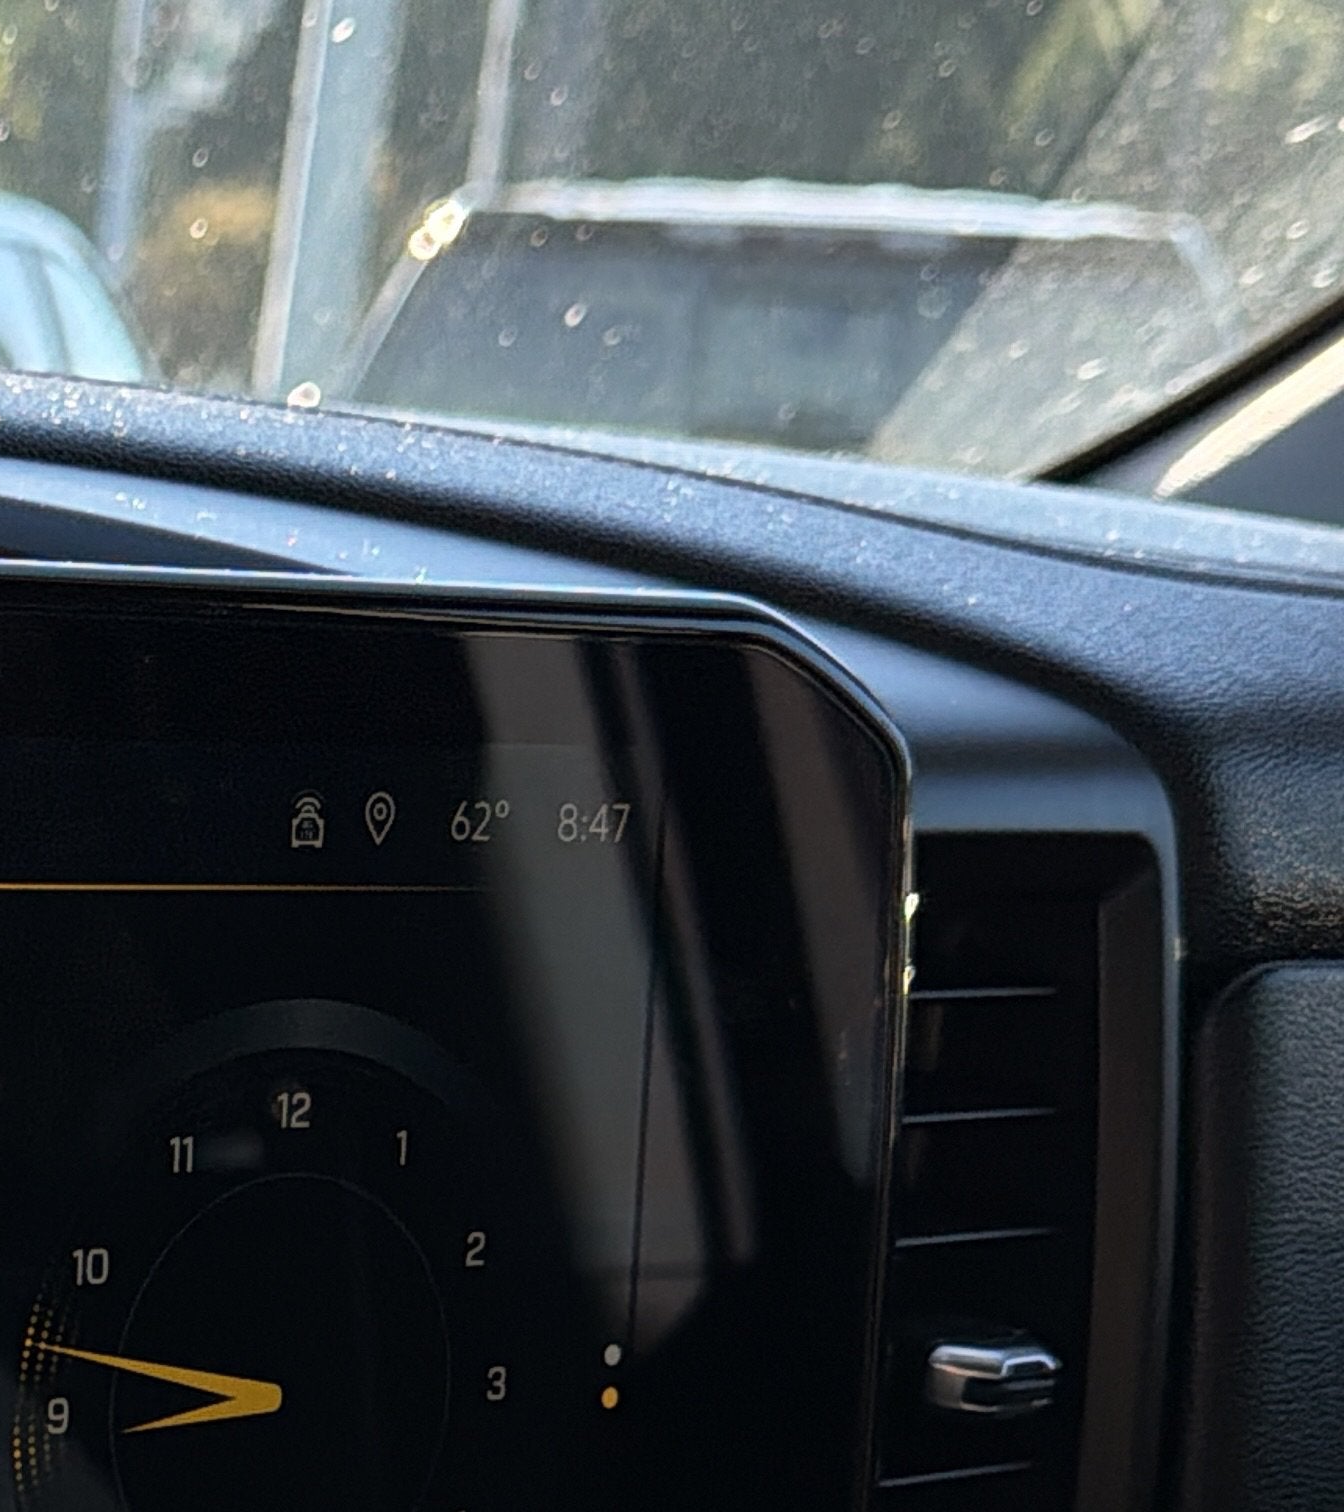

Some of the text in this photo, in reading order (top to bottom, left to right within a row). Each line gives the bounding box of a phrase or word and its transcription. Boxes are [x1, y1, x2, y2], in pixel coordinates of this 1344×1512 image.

[557, 802, 629, 843] 8:47
[277, 1091, 312, 1129] 12
[169, 1135, 194, 1173] 11
[396, 1129, 408, 1166] 1
[72, 1247, 109, 1286] 10
[465, 1231, 486, 1267] 2
[486, 1366, 507, 1401] 3
[45, 1397, 70, 1435] 9
